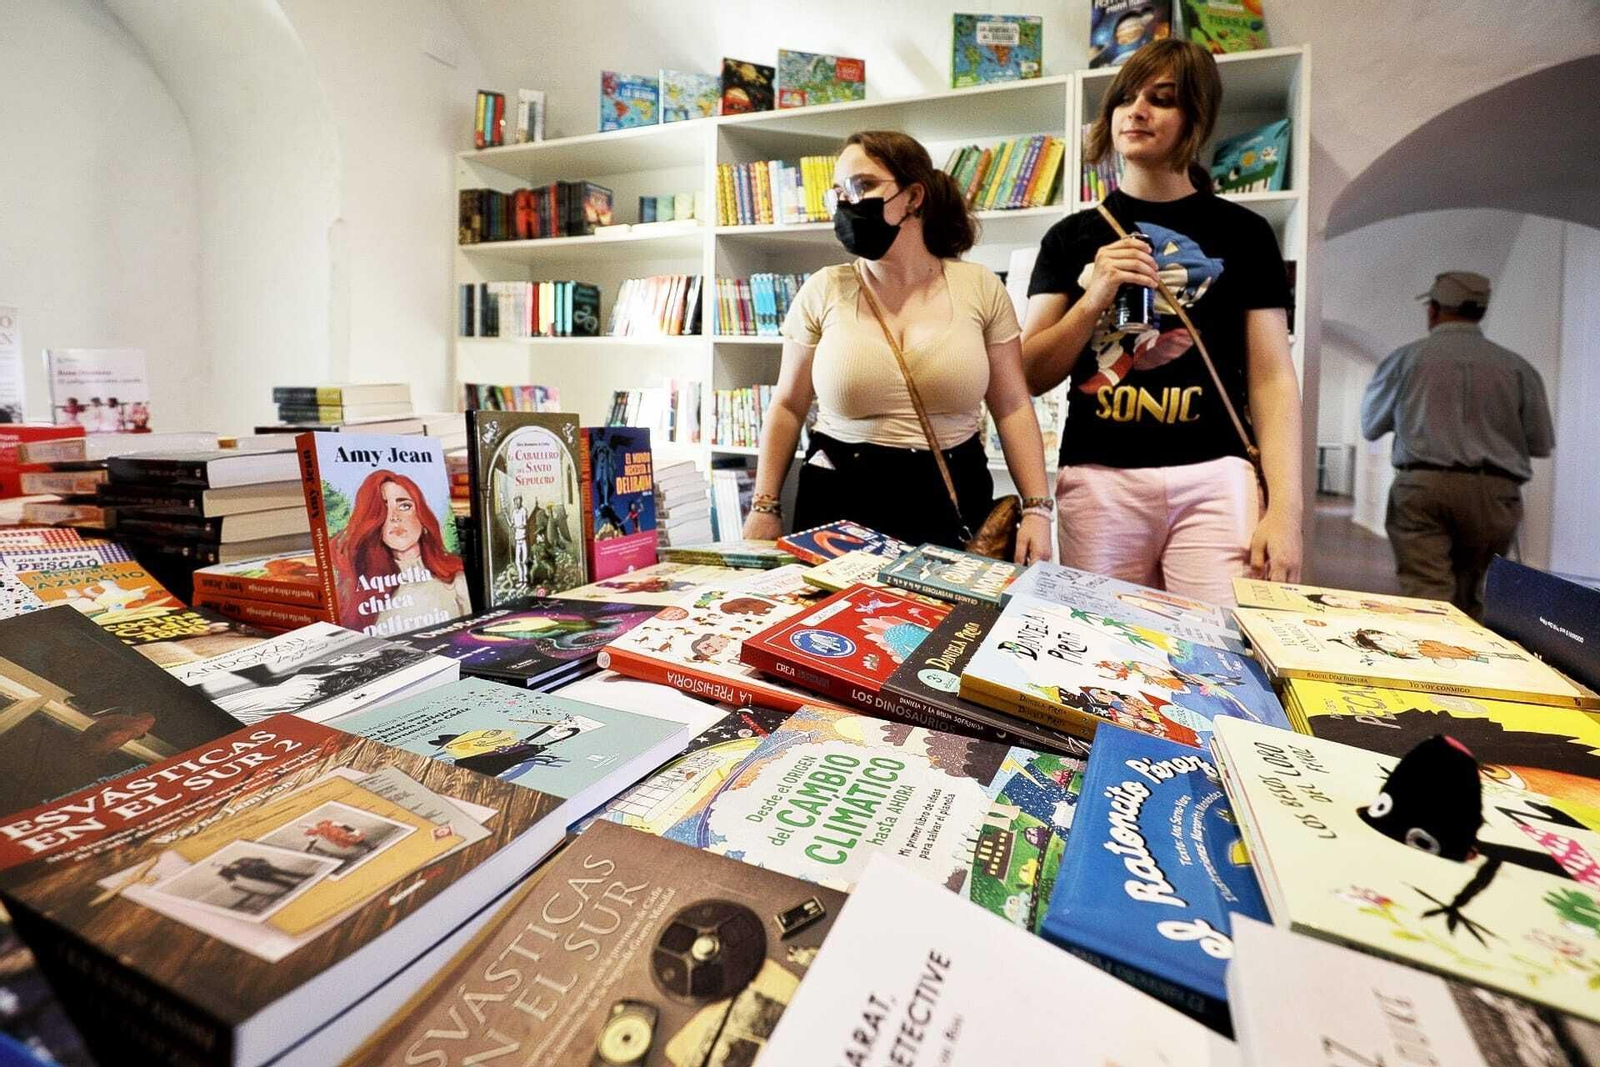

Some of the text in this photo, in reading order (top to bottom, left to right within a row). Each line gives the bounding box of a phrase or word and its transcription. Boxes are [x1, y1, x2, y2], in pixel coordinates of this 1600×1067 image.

[1095, 385, 1203, 424] SONIC
[334, 446, 434, 468] Amy Jean
[515, 450, 559, 461] CABALLERO
[526, 462, 552, 473] SANTO
[515, 476, 555, 487] SEPULCRO
[315, 527, 328, 571] pelirroja
[28, 570, 146, 590] AZPACHO
[356, 566, 433, 593] Aquella
[921, 585, 954, 600] INVENTORES
[358, 593, 414, 616] chica
[954, 594, 978, 606] GRANDES
[998, 613, 1049, 661] DANIELA
[1047, 630, 1088, 665] PIRATA
[775, 663, 796, 677] CREA
[925, 640, 967, 671] DANIELA
[666, 671, 753, 707] LA PREHISTORIA
[1435, 685, 1471, 694] CONMIGO
[852, 689, 956, 734] LOS DINOSAURIOS
[1125, 757, 1220, 785] Pérez
[1253, 741, 1302, 777] LOBO
[1, 729, 278, 841] ESVÁSTICAS
[19, 817, 108, 853] EN
[114, 791, 184, 821] EL
[186, 752, 279, 792] SUR
[274, 739, 303, 754] 2
[745, 755, 818, 824] Desde el ORIGEN
[776, 753, 861, 828] CAMBIO
[1257, 774, 1306, 808] BESOS
[1296, 783, 1334, 804] DEL
[151, 811, 225, 844] Wayne
[804, 756, 906, 865] CLIMÁTICO
[866, 784, 917, 847] hasta AHORA
[898, 788, 942, 857] Mi primer libro de ideas
[919, 793, 956, 861] para salvar el planeta
[1293, 813, 1339, 840] LOS
[770, 826, 796, 847] del
[1103, 780, 1189, 908] Ratoncito
[1170, 823, 1184, 840] Ana
[404, 853, 616, 1067] SVÁSTICAS
[462, 880, 650, 1067] N EL SUR
[889, 949, 951, 1067] ETECTIVE
